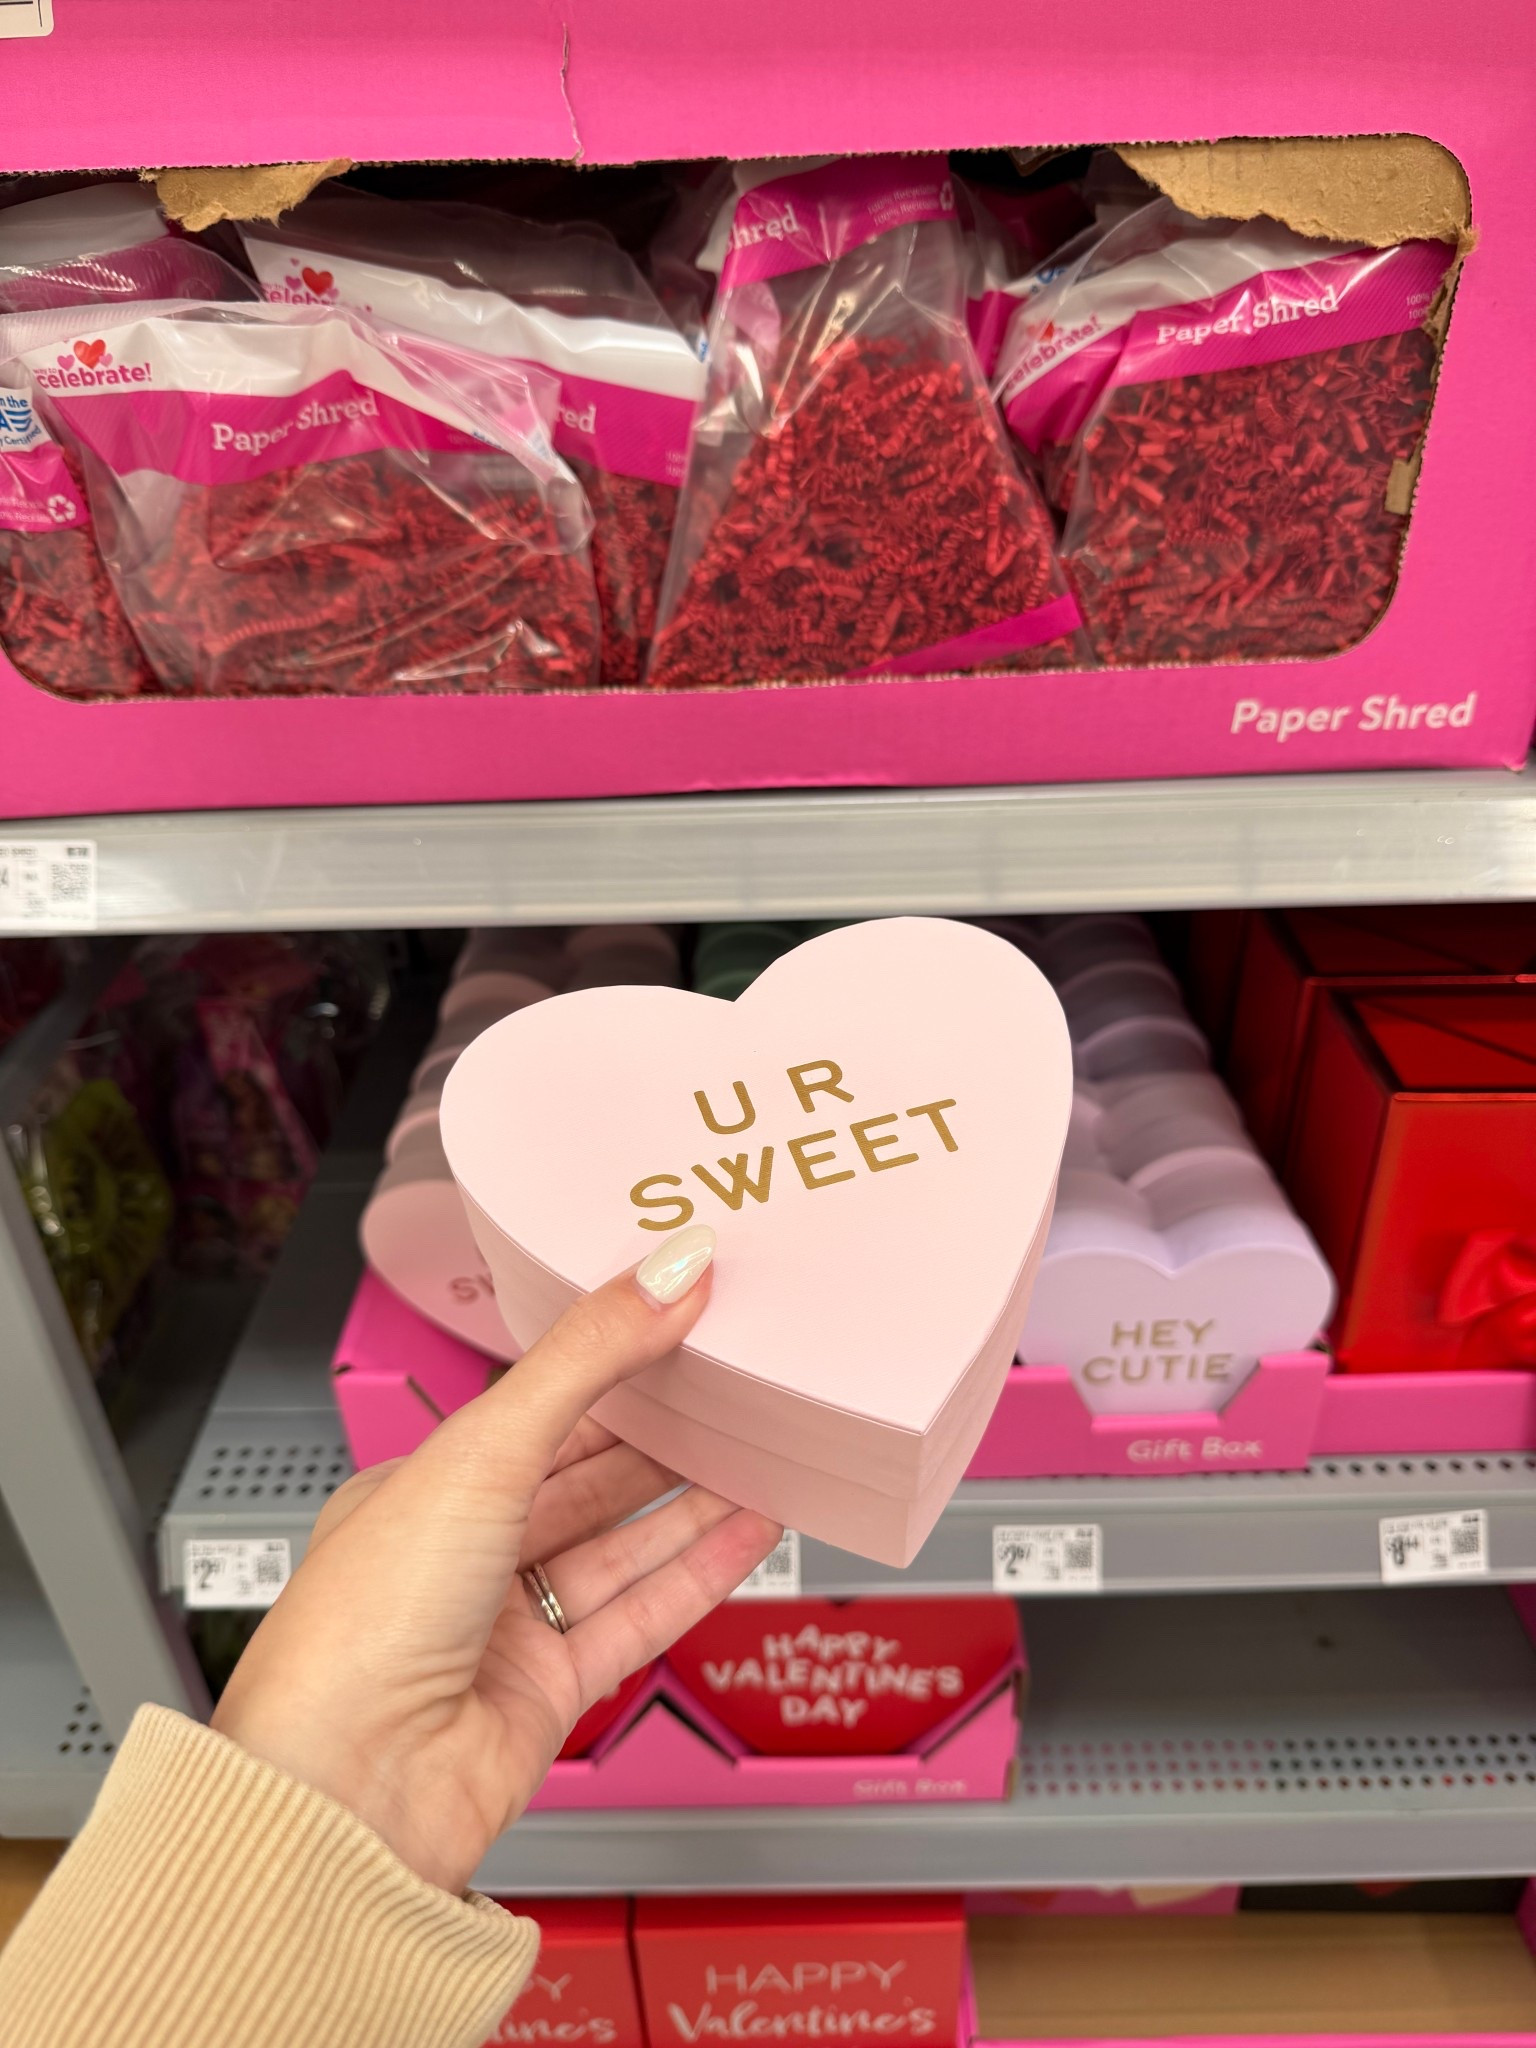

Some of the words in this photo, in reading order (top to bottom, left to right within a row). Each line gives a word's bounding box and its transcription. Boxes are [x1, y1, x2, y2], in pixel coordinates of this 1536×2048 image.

[1157, 308, 1244, 346] Paper
[1252, 285, 1339, 329] Shred
[36, 362, 152, 389] celebrate!
[211, 421, 294, 457] Paper
[296, 389, 379, 430] Shred
[1230, 698, 1350, 743] Paper
[1358, 691, 1478, 731] Shred
[693, 1081, 756, 1135] U
[786, 1059, 855, 1114] R
[629, 1098, 959, 1232] SWEET
[1110, 1319, 1215, 1348] HEY
[1081, 1353, 1234, 1385] CUTIE
[1126, 1439, 1194, 1464] Gift
[1202, 1436, 1264, 1460] Box
[763, 1624, 899, 1662] HAPPY
[780, 1695, 868, 1728] DAY
[705, 1959, 906, 1995] HAPPY
[667, 1996, 937, 2043] Valentine's
